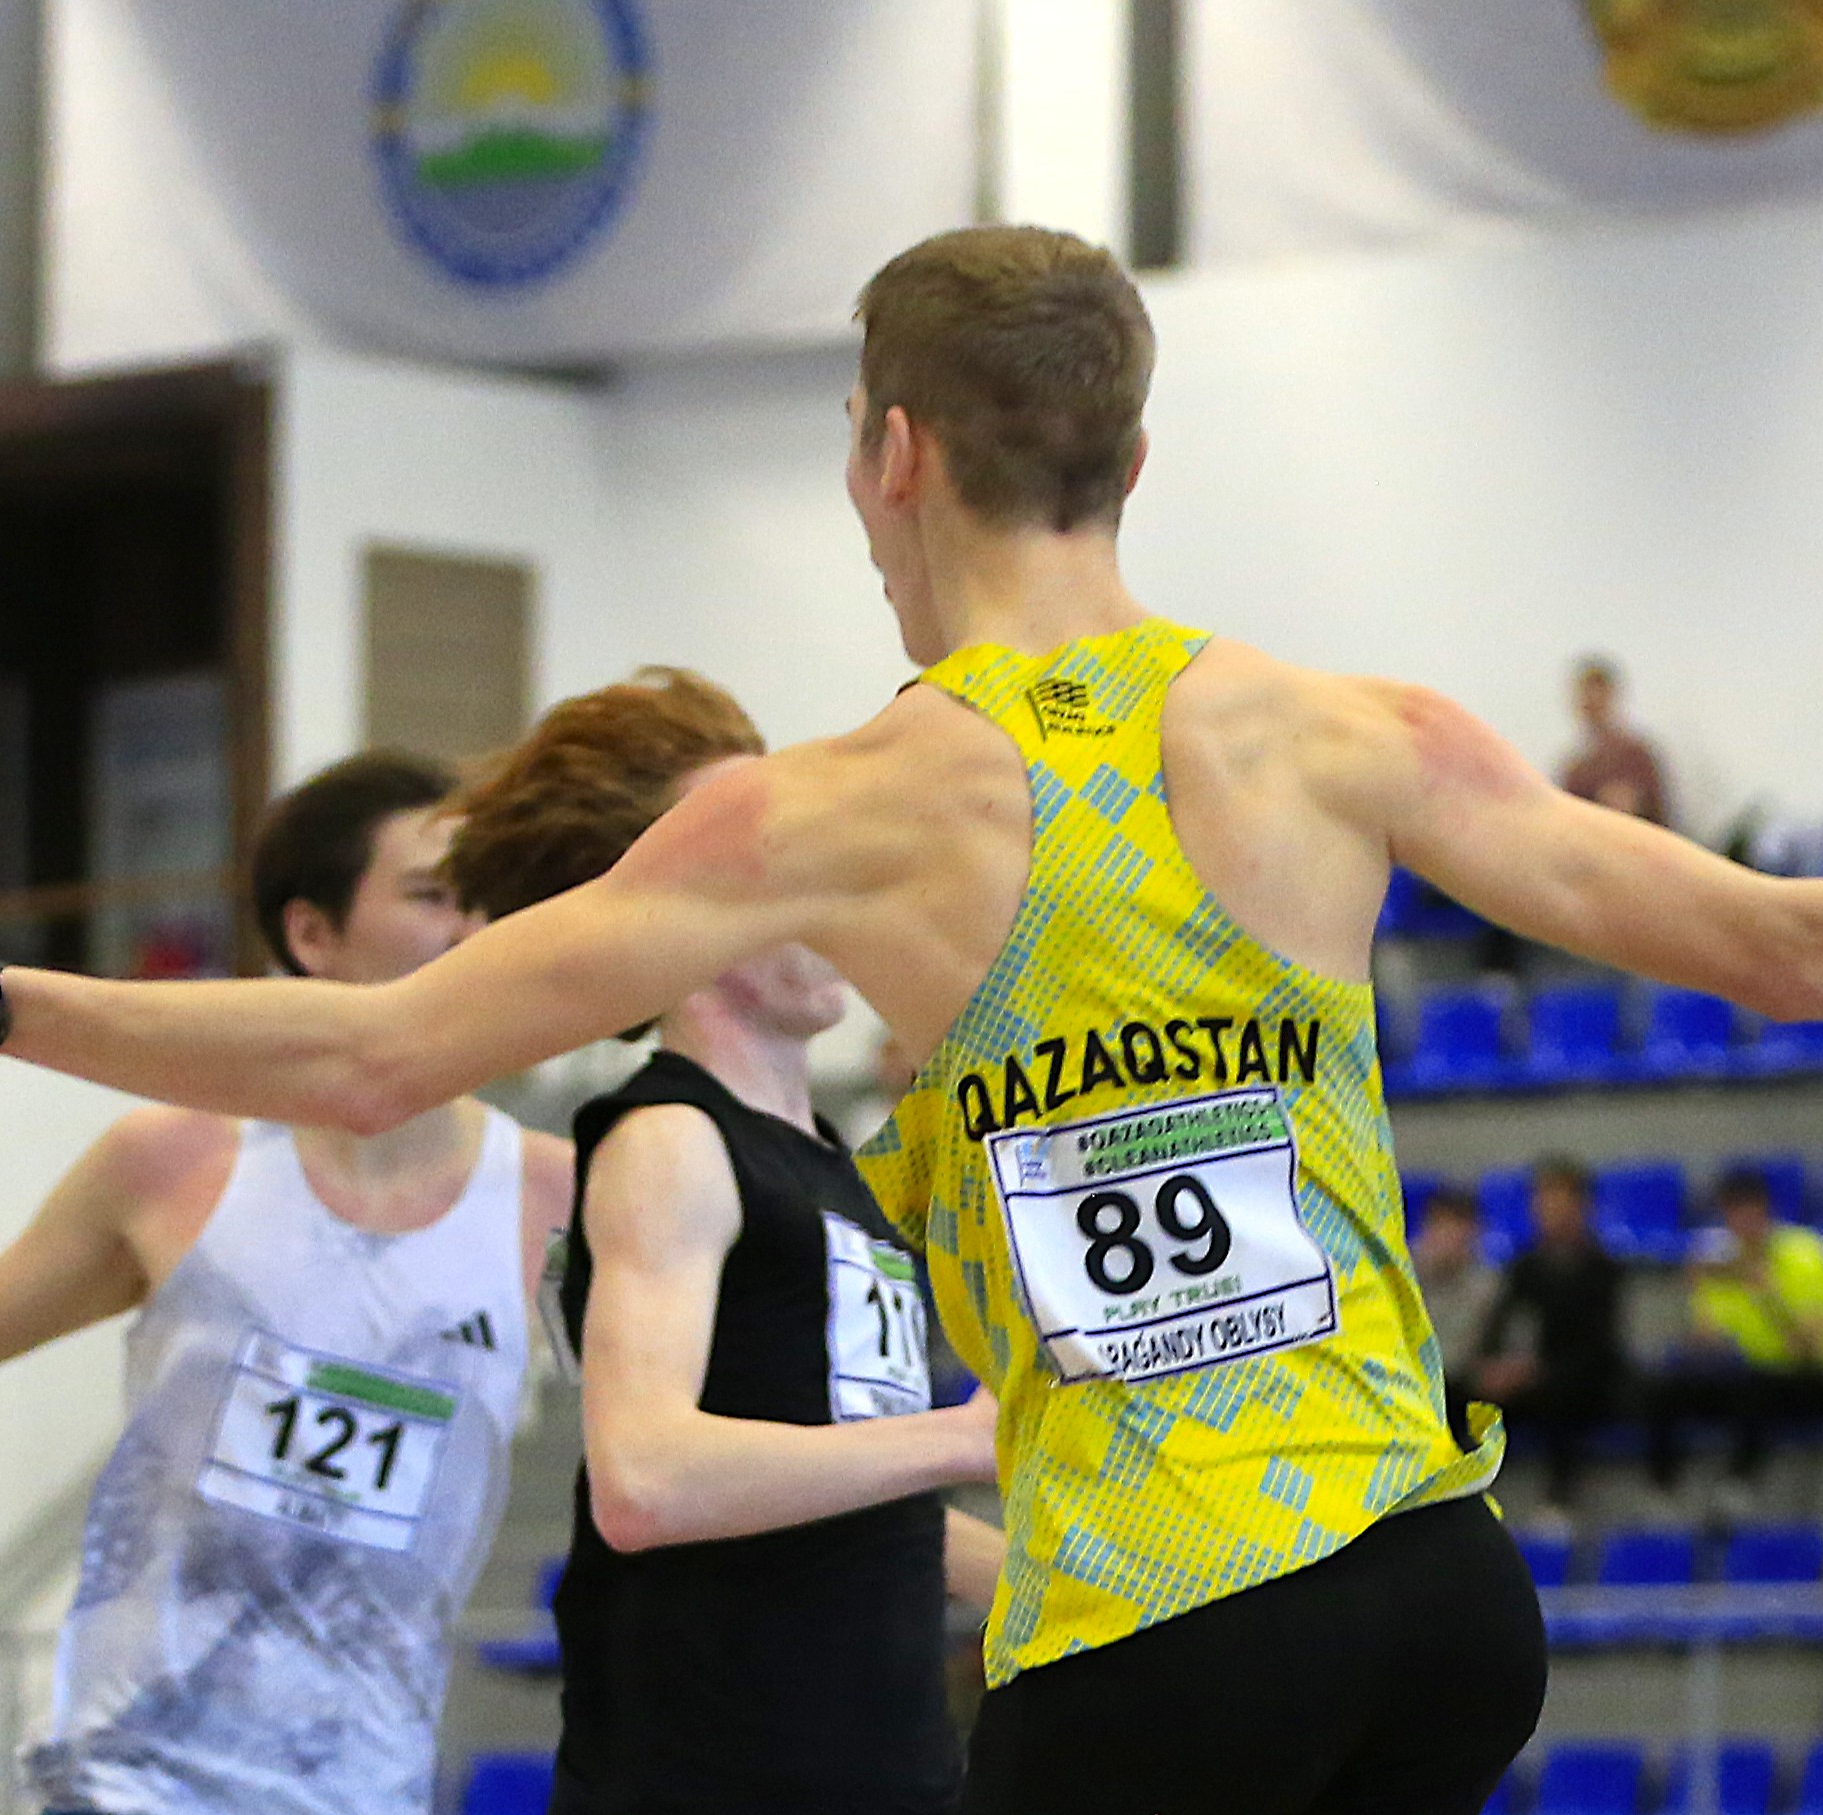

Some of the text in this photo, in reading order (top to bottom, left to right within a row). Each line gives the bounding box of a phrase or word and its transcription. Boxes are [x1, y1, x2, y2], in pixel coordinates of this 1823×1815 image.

[957, 1018, 1321, 1143] QAZAQSTAN
[1076, 1173, 1232, 1296] 89
[264, 1394, 405, 1491] 121
